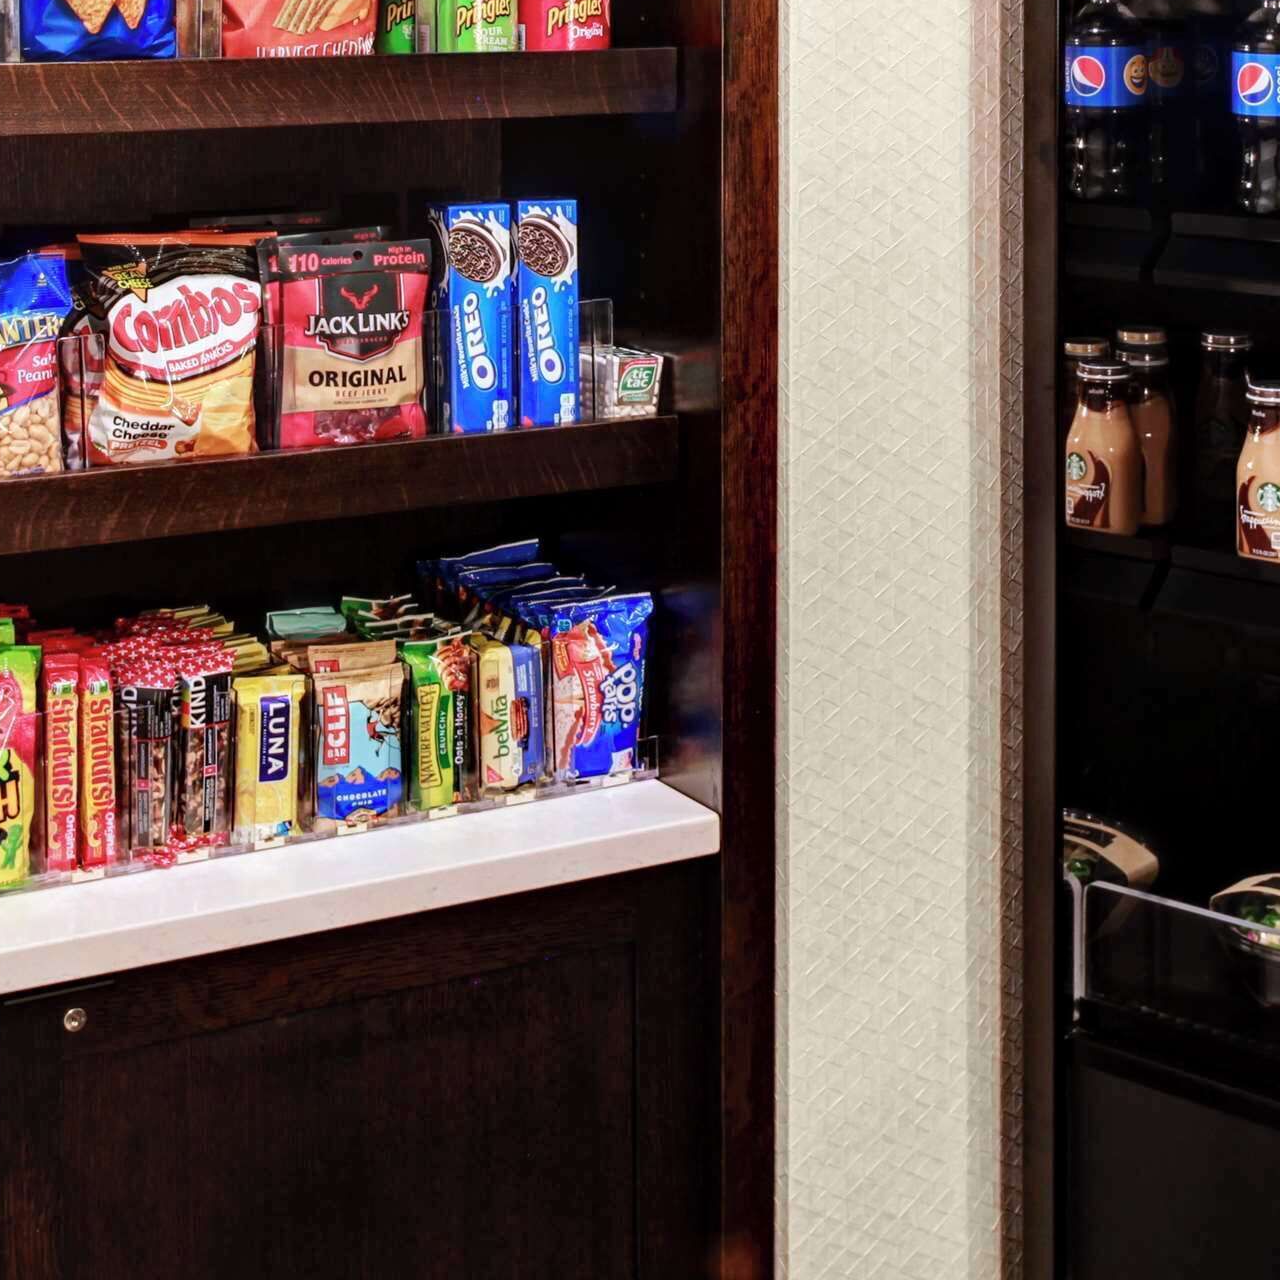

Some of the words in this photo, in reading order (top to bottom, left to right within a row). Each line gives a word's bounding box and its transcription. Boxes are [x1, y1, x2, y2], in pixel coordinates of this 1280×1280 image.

[289, 253, 319, 272] 110
[321, 255, 352, 266] Calories
[373, 253, 426, 266] Protein
[117, 279, 152, 289] CHEESE
[113, 282, 260, 354] Combos
[305, 316, 357, 336] JACK
[531, 286, 565, 384] OREO
[169, 359, 199, 372] BAKED
[200, 342, 233, 365] SNACKS
[463, 292, 498, 391] OREO
[308, 366, 407, 388] ORIGINAL
[627, 377, 649, 389] tac
[632, 367, 651, 379] tic
[112, 415, 175, 431] Cheddar
[112, 429, 169, 441] Cheese
[111, 439, 162, 450] PRETZEL
[190, 675, 206, 728] KIND
[327, 691, 348, 748] CLIF
[420, 689, 437, 733] VALLEY
[454, 694, 465, 727] Honey
[582, 669, 600, 734] Strawberry
[267, 702, 286, 775] LUNA
[438, 710, 447, 755] CRUNCHY
[491, 695, 511, 760] belVita
[51, 698, 75, 811] Starburst
[89, 697, 115, 810] Starburst
[327, 748, 346, 759] BAR
[420, 733, 438, 785] NATURE
[454, 741, 464, 765] Oats
[336, 788, 387, 802] CHOCOLATE
[65, 813, 76, 859] Original
[104, 810, 116, 856] Original
